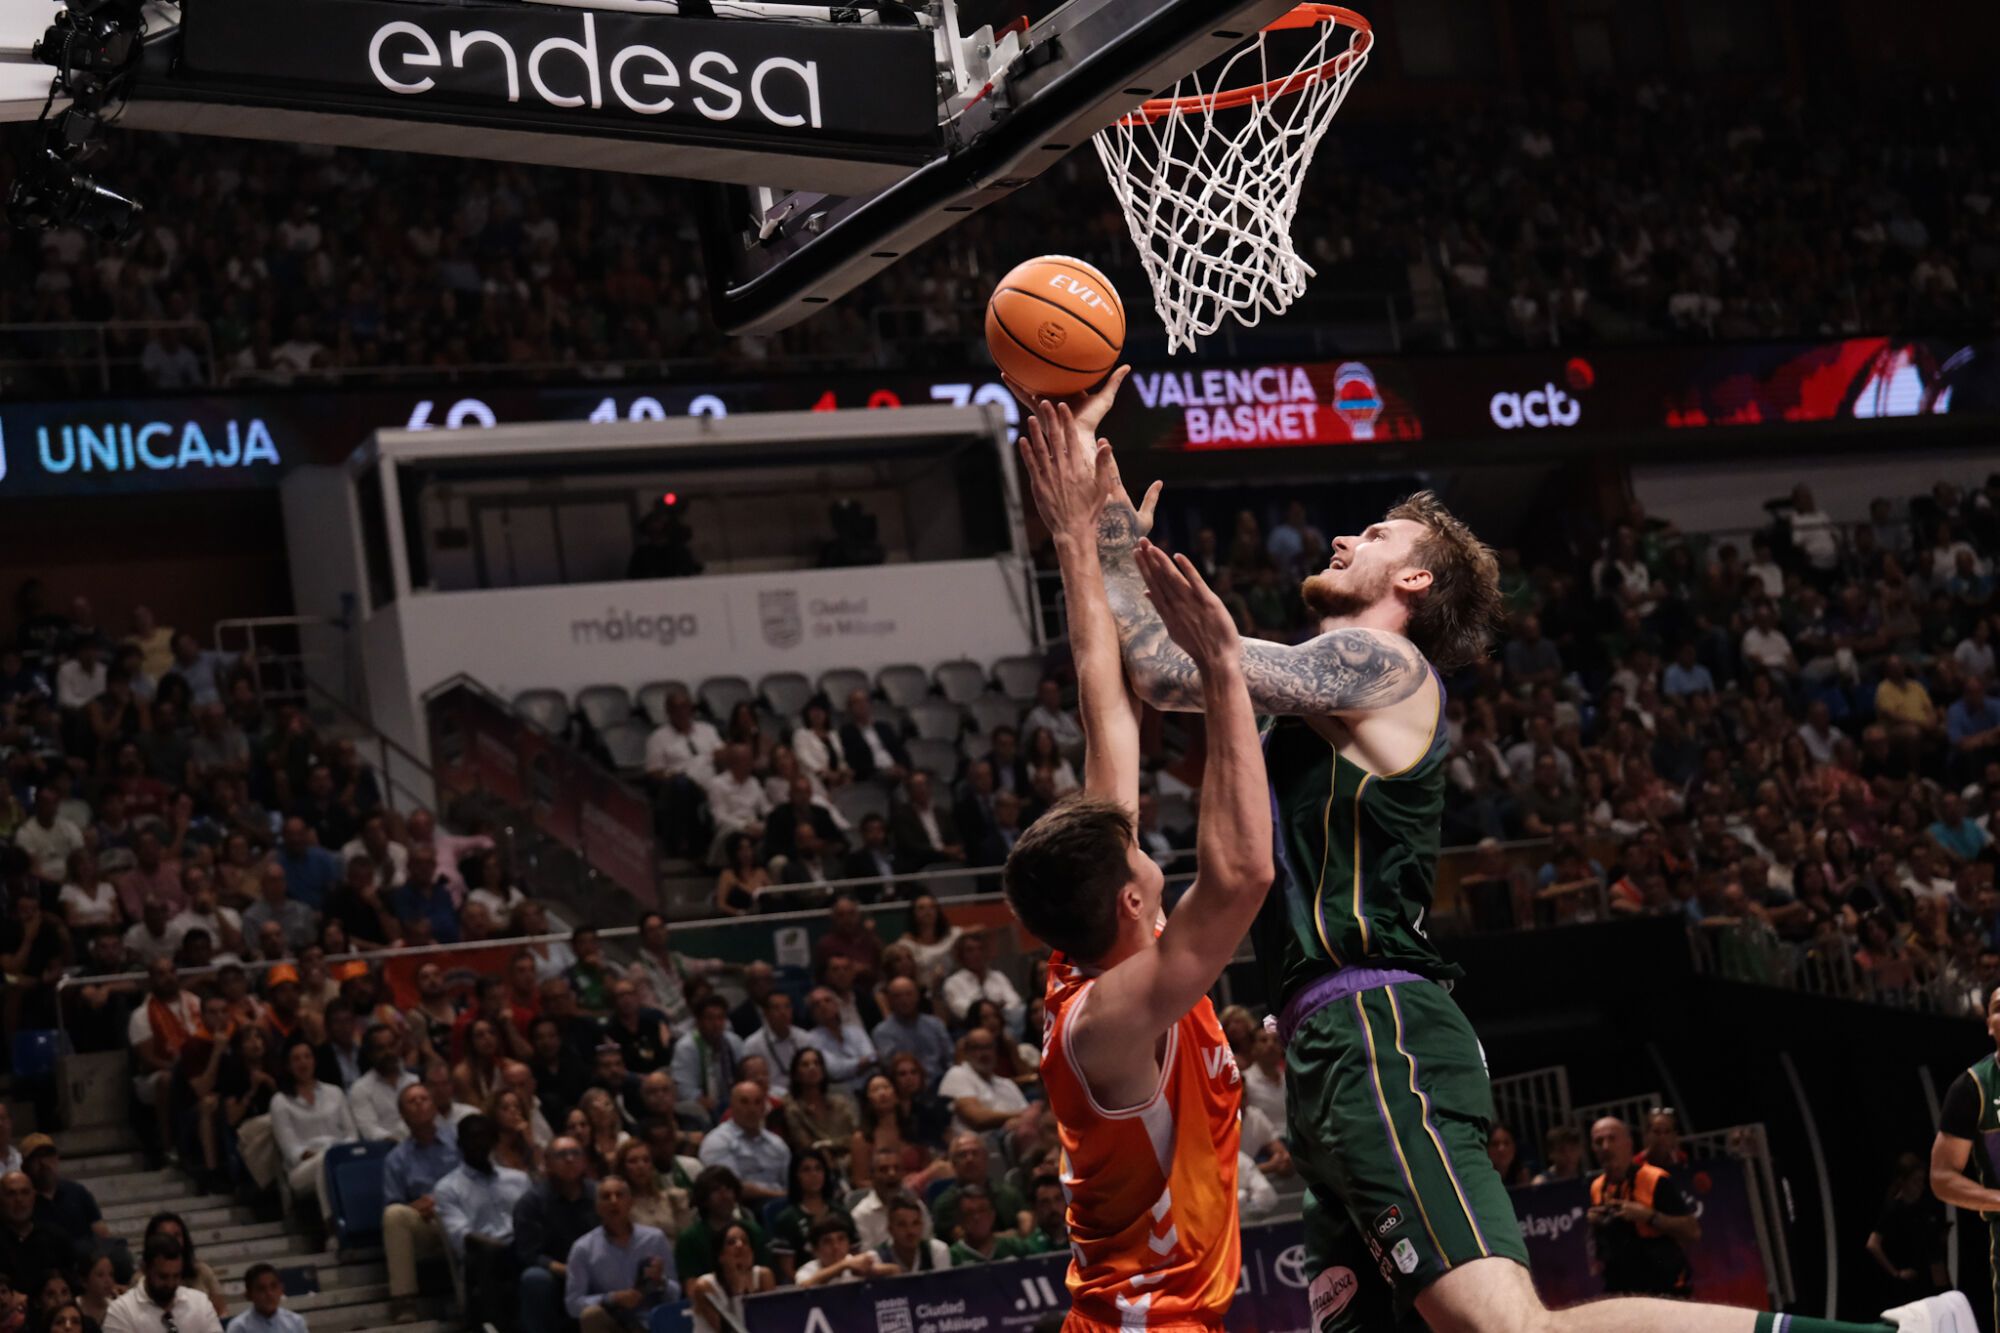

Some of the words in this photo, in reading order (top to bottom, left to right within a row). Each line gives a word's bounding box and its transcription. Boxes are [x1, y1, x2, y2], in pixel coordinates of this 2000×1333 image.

[367, 12, 823, 129] endesa
[1132, 365, 1316, 409] VALENCIA
[1489, 383, 1581, 428] acb
[36, 418, 281, 474] UNICAJA
[1184, 402, 1319, 446] BASKET
[1379, 1217, 1397, 1233] acb
[1519, 1214, 1575, 1240] elayo
[916, 1300, 965, 1318] Ciudad
[938, 1315, 989, 1333] Málaga
